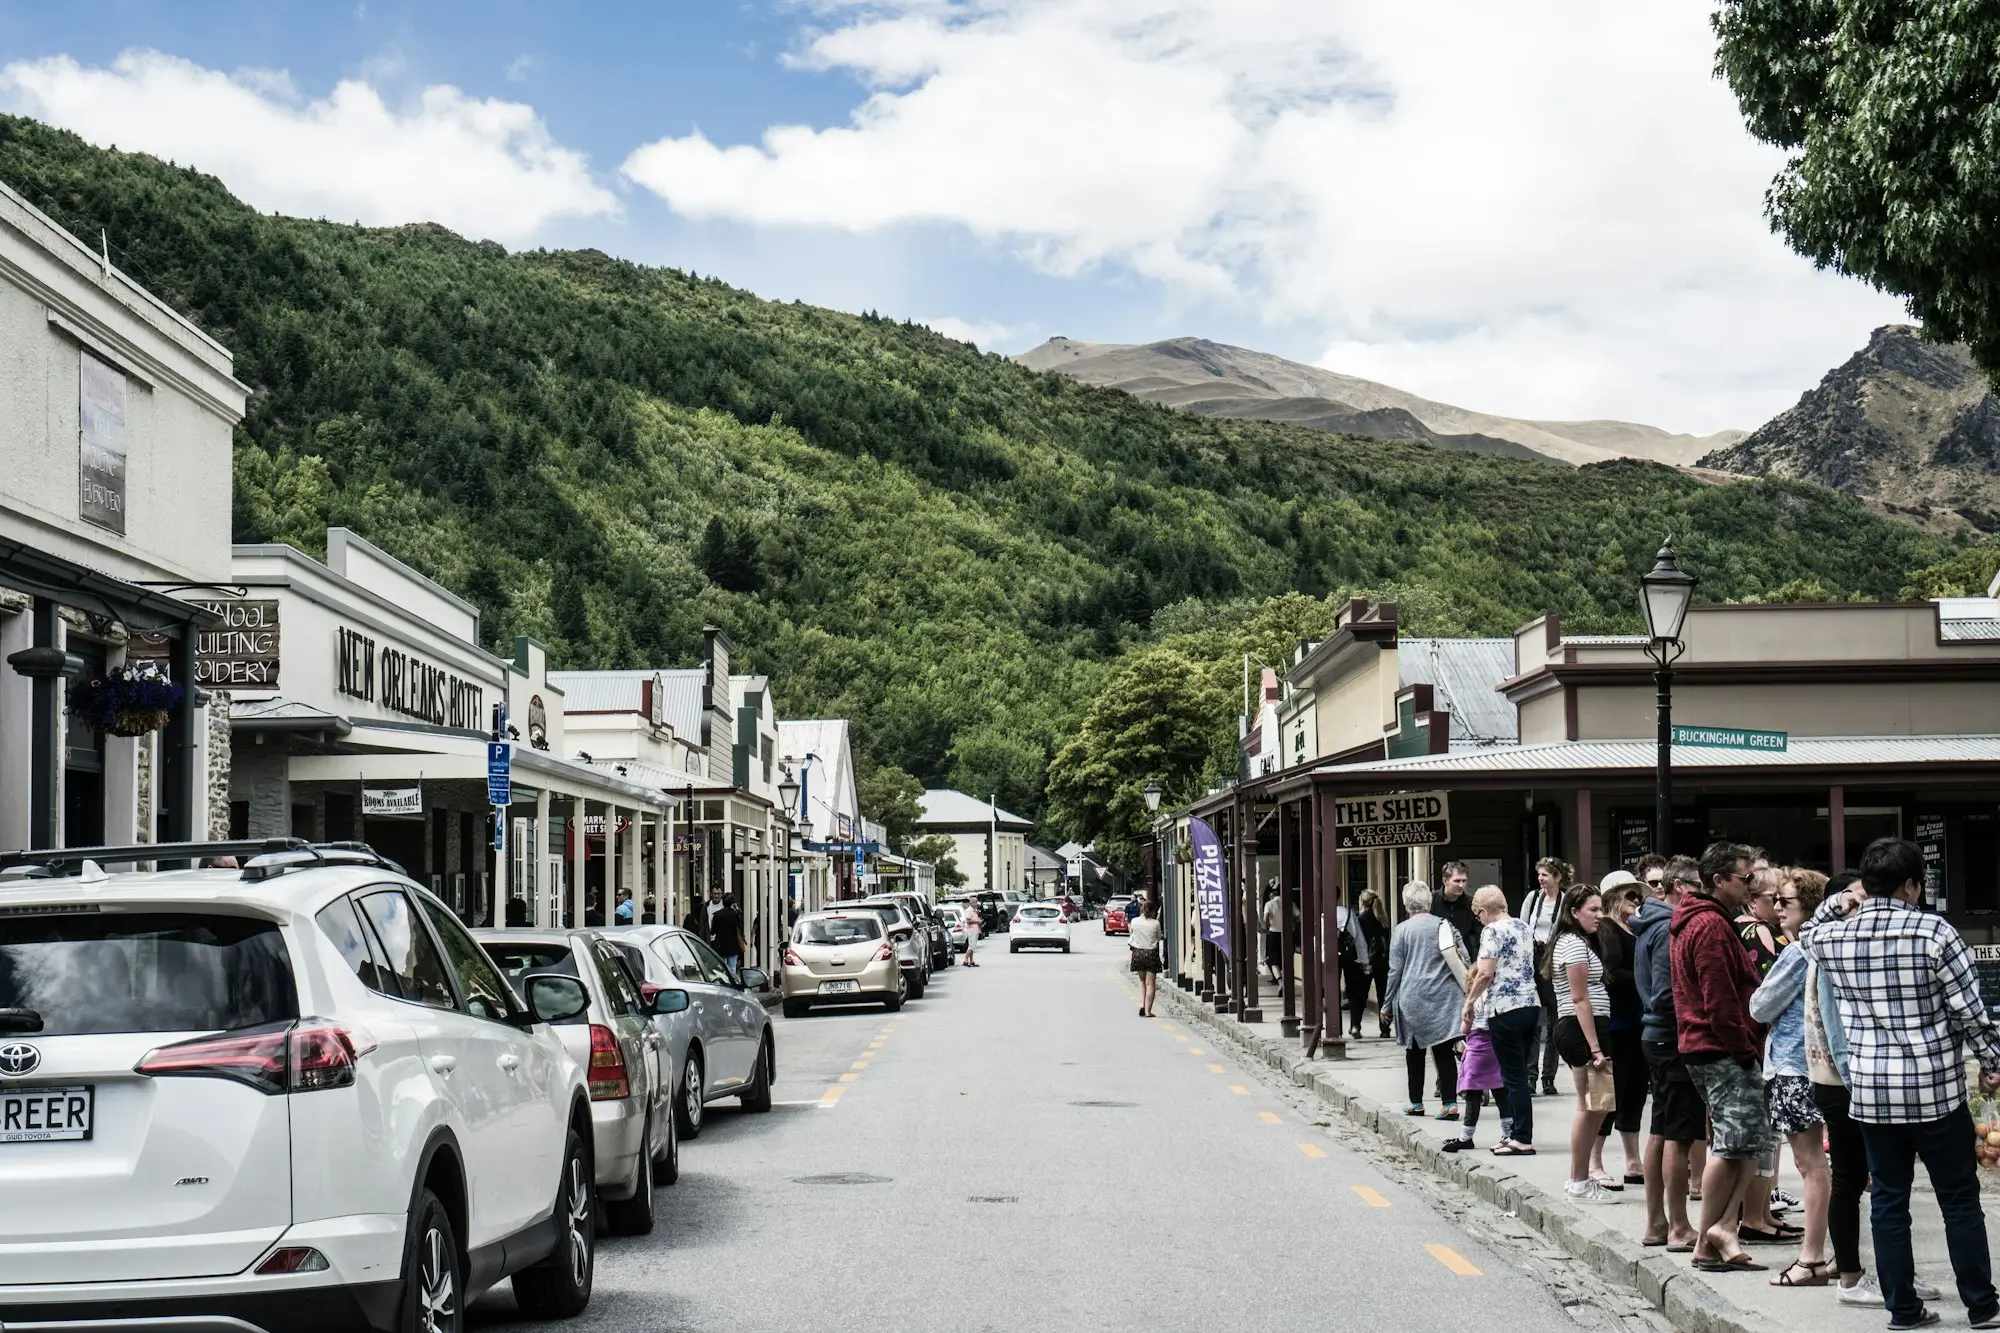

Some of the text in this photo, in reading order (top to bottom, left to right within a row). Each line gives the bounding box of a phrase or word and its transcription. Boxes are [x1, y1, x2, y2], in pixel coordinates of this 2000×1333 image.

[206, 602, 273, 628] WOOL
[195, 631, 273, 656] UILTING
[339, 626, 375, 703] NEW
[381, 646, 446, 726] ORLEANS
[1679, 730, 1784, 748] BUCKINGHAM GREEN
[495, 744, 504, 760] P
[363, 795, 385, 807] ROOMS
[387, 793, 419, 807] AVAILABLE
[1335, 796, 1442, 825] THE SHED
[1353, 822, 1426, 837] ICE CREAM
[1342, 831, 1438, 848] & TAKEAWAYS
[1923, 844, 1938, 854] Milk
[1195, 857, 1210, 920] OPEN
[1201, 844, 1225, 939] PIZZERIA
[1973, 947, 1993, 959] THE
[0, 1096, 86, 1131] REER
[6, 1132, 52, 1141] GWD TOYOTA
[173, 1175, 211, 1187] AWD
